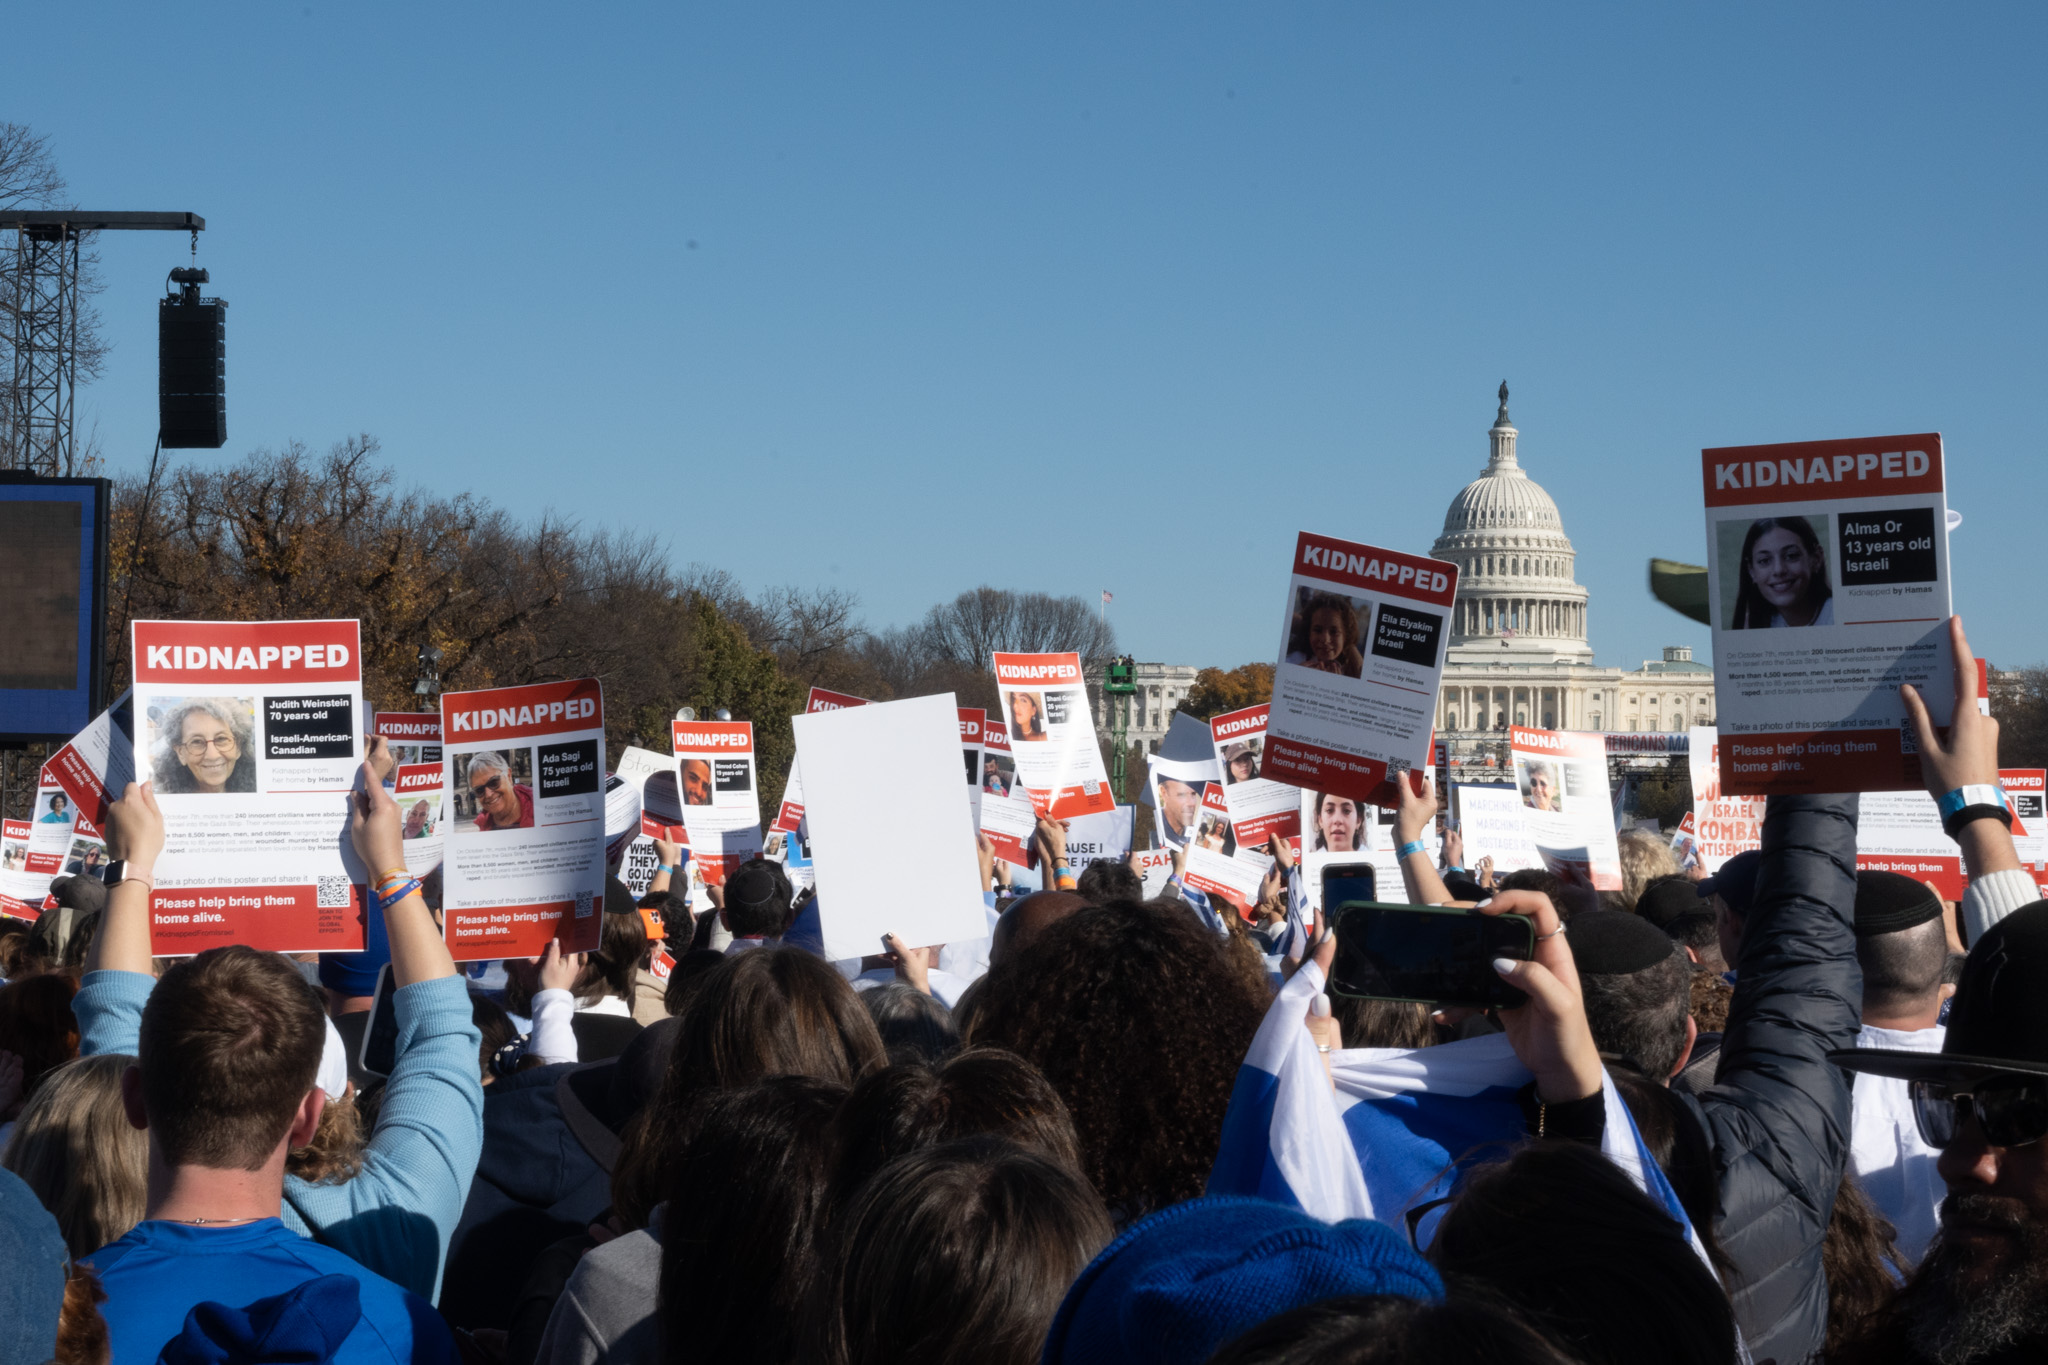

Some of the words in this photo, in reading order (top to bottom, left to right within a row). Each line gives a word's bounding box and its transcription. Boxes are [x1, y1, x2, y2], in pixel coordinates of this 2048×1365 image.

[1714, 448, 1930, 490] KIDNAPPED
[1843, 521, 1880, 536] Alma
[1884, 519, 1902, 533] Or
[1845, 540, 1862, 554] 13
[1865, 540, 1904, 555] years
[1908, 536, 1931, 550] old
[1302, 545, 1449, 593] KIDNAPPED
[1846, 557, 1889, 572] Israeli
[1848, 587, 1891, 598] Kidnapped
[1892, 586, 1902, 596] by
[1904, 585, 1932, 593] Hamas
[1381, 613, 1398, 624] Ella
[1398, 617, 1433, 634] Elyakim
[1379, 624, 1386, 634] 8
[1386, 627, 1410, 641] years
[1411, 632, 1426, 643] old
[1377, 636, 1404, 649] Israeli
[1824, 646, 1855, 655] innocent
[1856, 645, 1884, 653] civilians
[1904, 642, 1937, 651] abducted
[146, 644, 350, 670] KIDNAPPED
[999, 664, 1077, 679] KIDNAPPED
[1728, 672, 1745, 680] More
[1746, 671, 1761, 679] than
[1782, 670, 1809, 678] women,
[1810, 669, 1827, 677] men,
[269, 699, 300, 708] Judith
[301, 698, 349, 708] Weinstein
[269, 711, 281, 720] 70
[283, 712, 310, 722] years
[312, 710, 328, 719] old
[452, 697, 595, 732] KIDNAPPED
[1730, 722, 1750, 731] Take
[1759, 721, 1784, 731] photo
[1785, 720, 1794, 729] of
[1795, 720, 1811, 729] this
[1812, 719, 1839, 730] poster
[1841, 718, 1856, 727] and
[1858, 717, 1881, 726] share
[1882, 717, 1890, 726] it
[270, 733, 352, 743] Israeli-American-
[676, 732, 748, 746] KIDNAPPED
[1276, 728, 1290, 737] Take
[1295, 733, 1312, 744] photo
[1319, 738, 1330, 747] this
[1330, 741, 1348, 752] poster
[1349, 745, 1361, 753] and
[1361, 748, 1377, 758] share
[270, 745, 316, 754] Canadian
[1732, 743, 1773, 756] Please
[1777, 742, 1804, 756] help
[1807, 741, 1841, 755] bring
[1844, 740, 1877, 752] them
[542, 753, 559, 763] Ada
[561, 750, 580, 763] Sagi
[1273, 744, 1302, 758] Please
[1302, 751, 1323, 764] help
[1323, 756, 1347, 771] bring
[1348, 761, 1371, 774] them
[61, 756, 75, 774] home
[542, 766, 553, 776] 75
[555, 764, 578, 776] years
[580, 761, 593, 771] old
[1271, 755, 1296, 768] home
[1296, 761, 1320, 775] alive.
[1733, 760, 1768, 772] home
[1771, 759, 1804, 771] alive.
[67, 752, 83, 771] Please
[80, 767, 92, 783] help
[89, 781, 102, 797] bring
[306, 776, 316, 784] by
[543, 776, 569, 788] Israeli
[1712, 804, 1756, 818] ISRAEL
[629, 856, 658, 868] THEY
[1868, 862, 1889, 871] help
[1891, 862, 1917, 873] bring
[1918, 863, 1943, 871] them
[154, 877, 173, 885] Take
[183, 877, 205, 886] photo
[207, 876, 216, 884] of
[217, 876, 232, 884] this
[234, 876, 259, 885] poster
[261, 875, 276, 883] and
[300, 874, 308, 882] it
[627, 868, 641, 880] GO
[154, 897, 196, 909] Please
[198, 896, 225, 909] help
[228, 895, 261, 909] bring
[264, 894, 295, 905] them
[457, 899, 471, 907] Take
[478, 898, 496, 907] photo
[517, 896, 536, 904] poster
[154, 912, 189, 924] home
[192, 911, 225, 923] alive.
[455, 913, 488, 925] Please
[490, 912, 511, 924] help
[513, 910, 538, 924] bring
[540, 909, 562, 919] them
[455, 926, 483, 937] home
[484, 924, 510, 935] alive.
